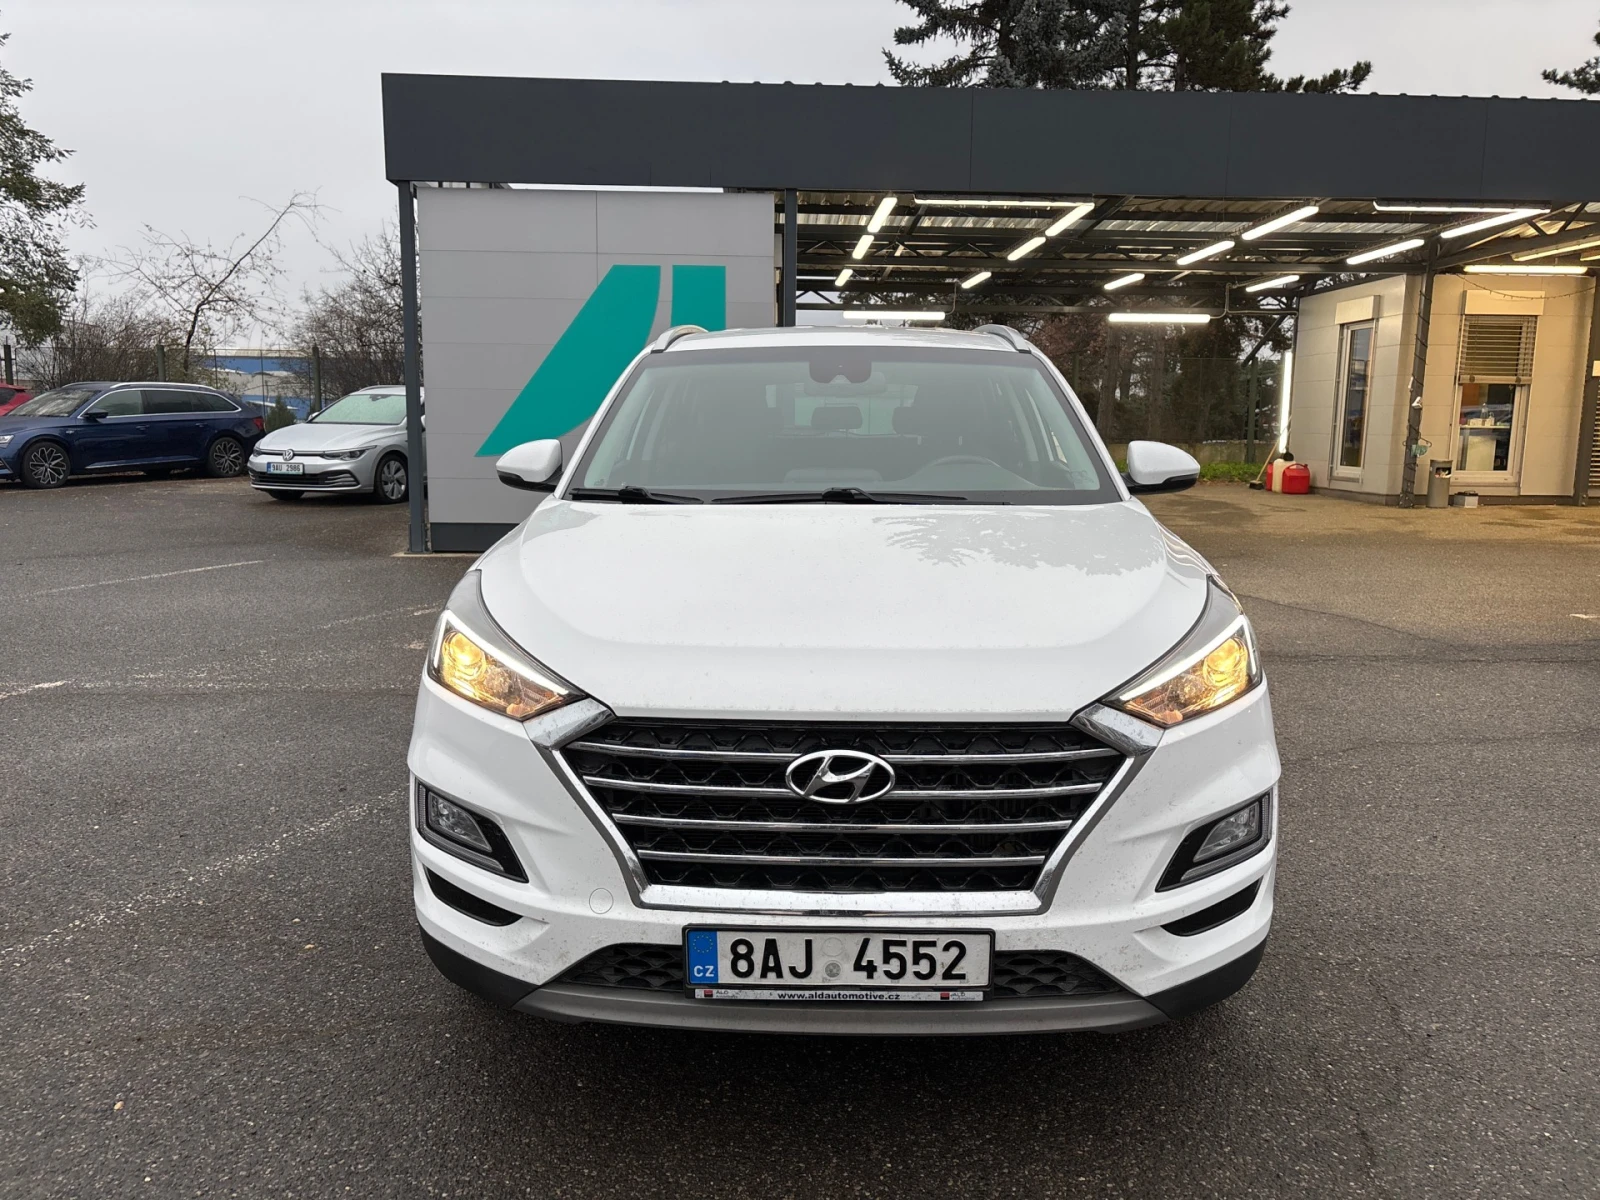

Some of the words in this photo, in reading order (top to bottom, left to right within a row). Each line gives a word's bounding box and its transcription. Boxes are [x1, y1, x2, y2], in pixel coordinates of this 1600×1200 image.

[730, 938, 813, 979] 8AJ
[853, 938, 967, 980] 4552
[693, 965, 715, 978] CZ
[777, 991, 901, 1000] www.aldautomotive.cz
